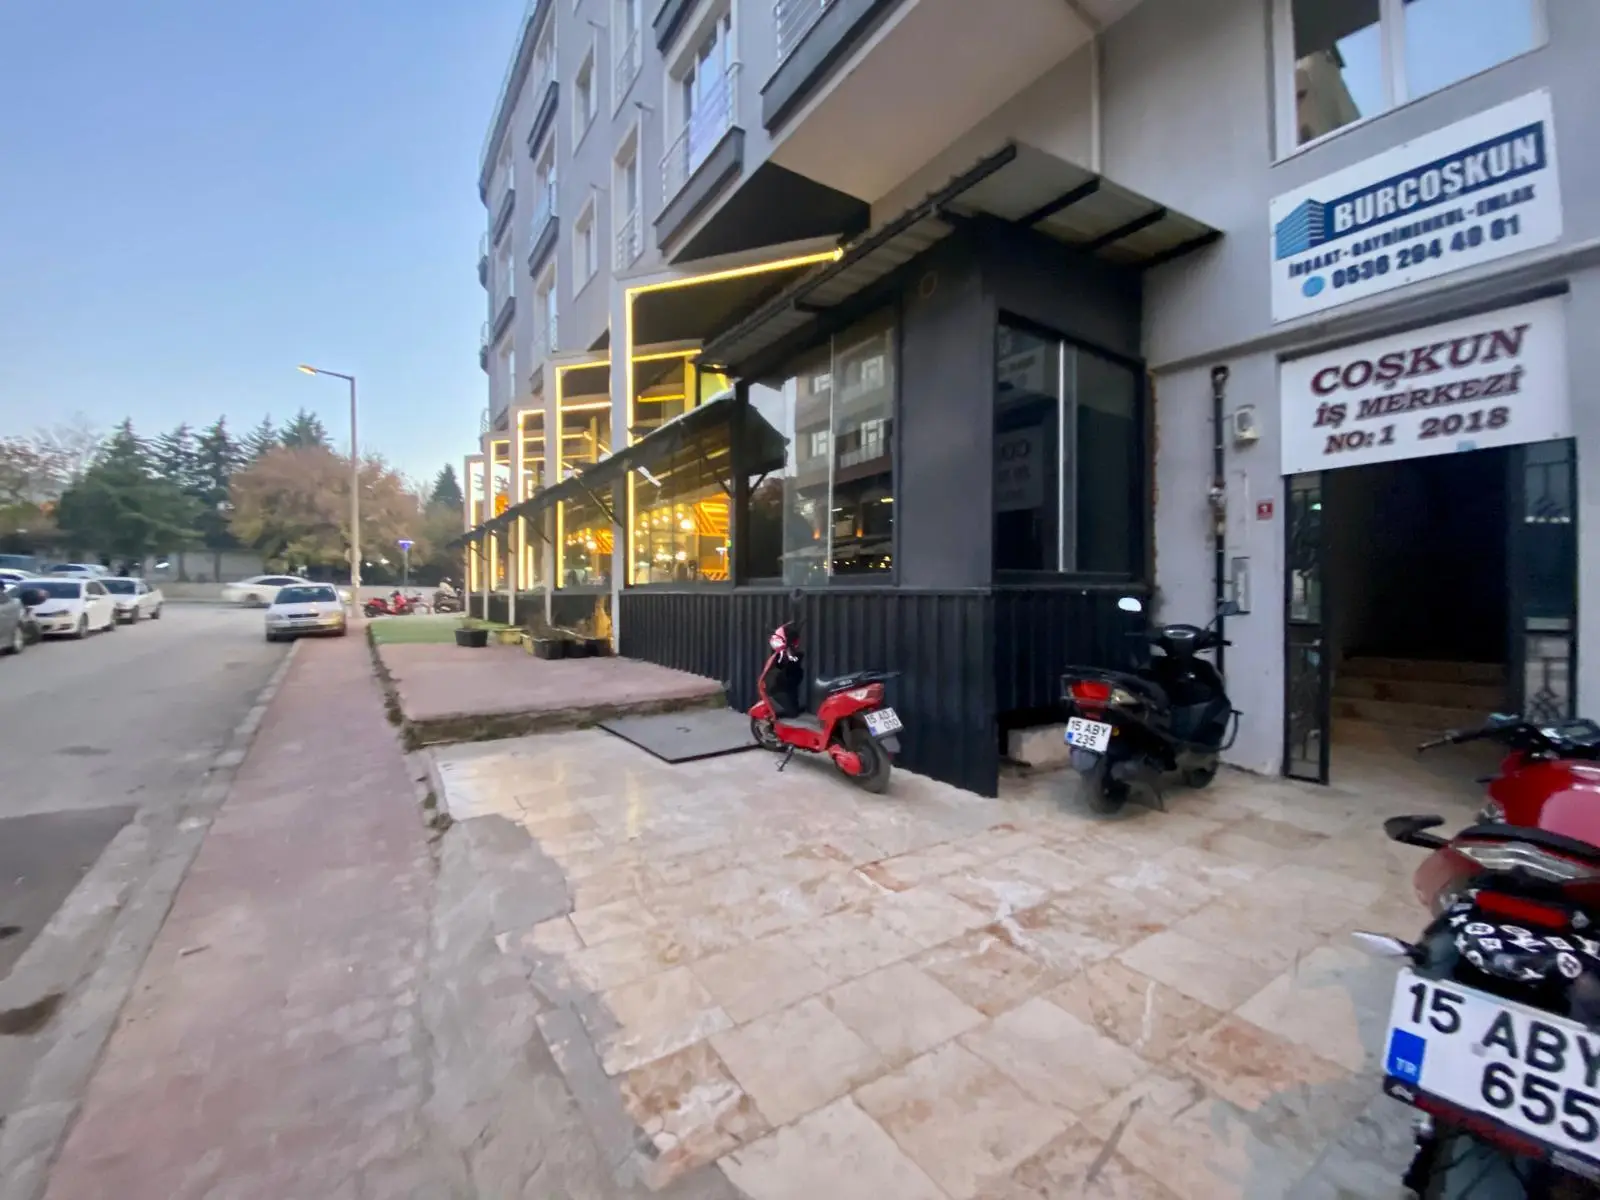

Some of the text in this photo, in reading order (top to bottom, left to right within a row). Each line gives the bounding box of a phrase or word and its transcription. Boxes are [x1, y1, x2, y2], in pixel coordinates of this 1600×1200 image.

[1311, 324, 1530, 396] COŞKUN
[1313, 365, 1525, 428] İŞ MERKEZİ
[1323, 407, 1510, 455] NO:1 2018
[1072, 720, 1108, 737] 15 ABY
[1075, 733, 1096, 746] 235
[1409, 982, 1600, 1089] 15 ABY
[1396, 1057, 1418, 1077] TR
[1481, 1061, 1600, 1143] 655
